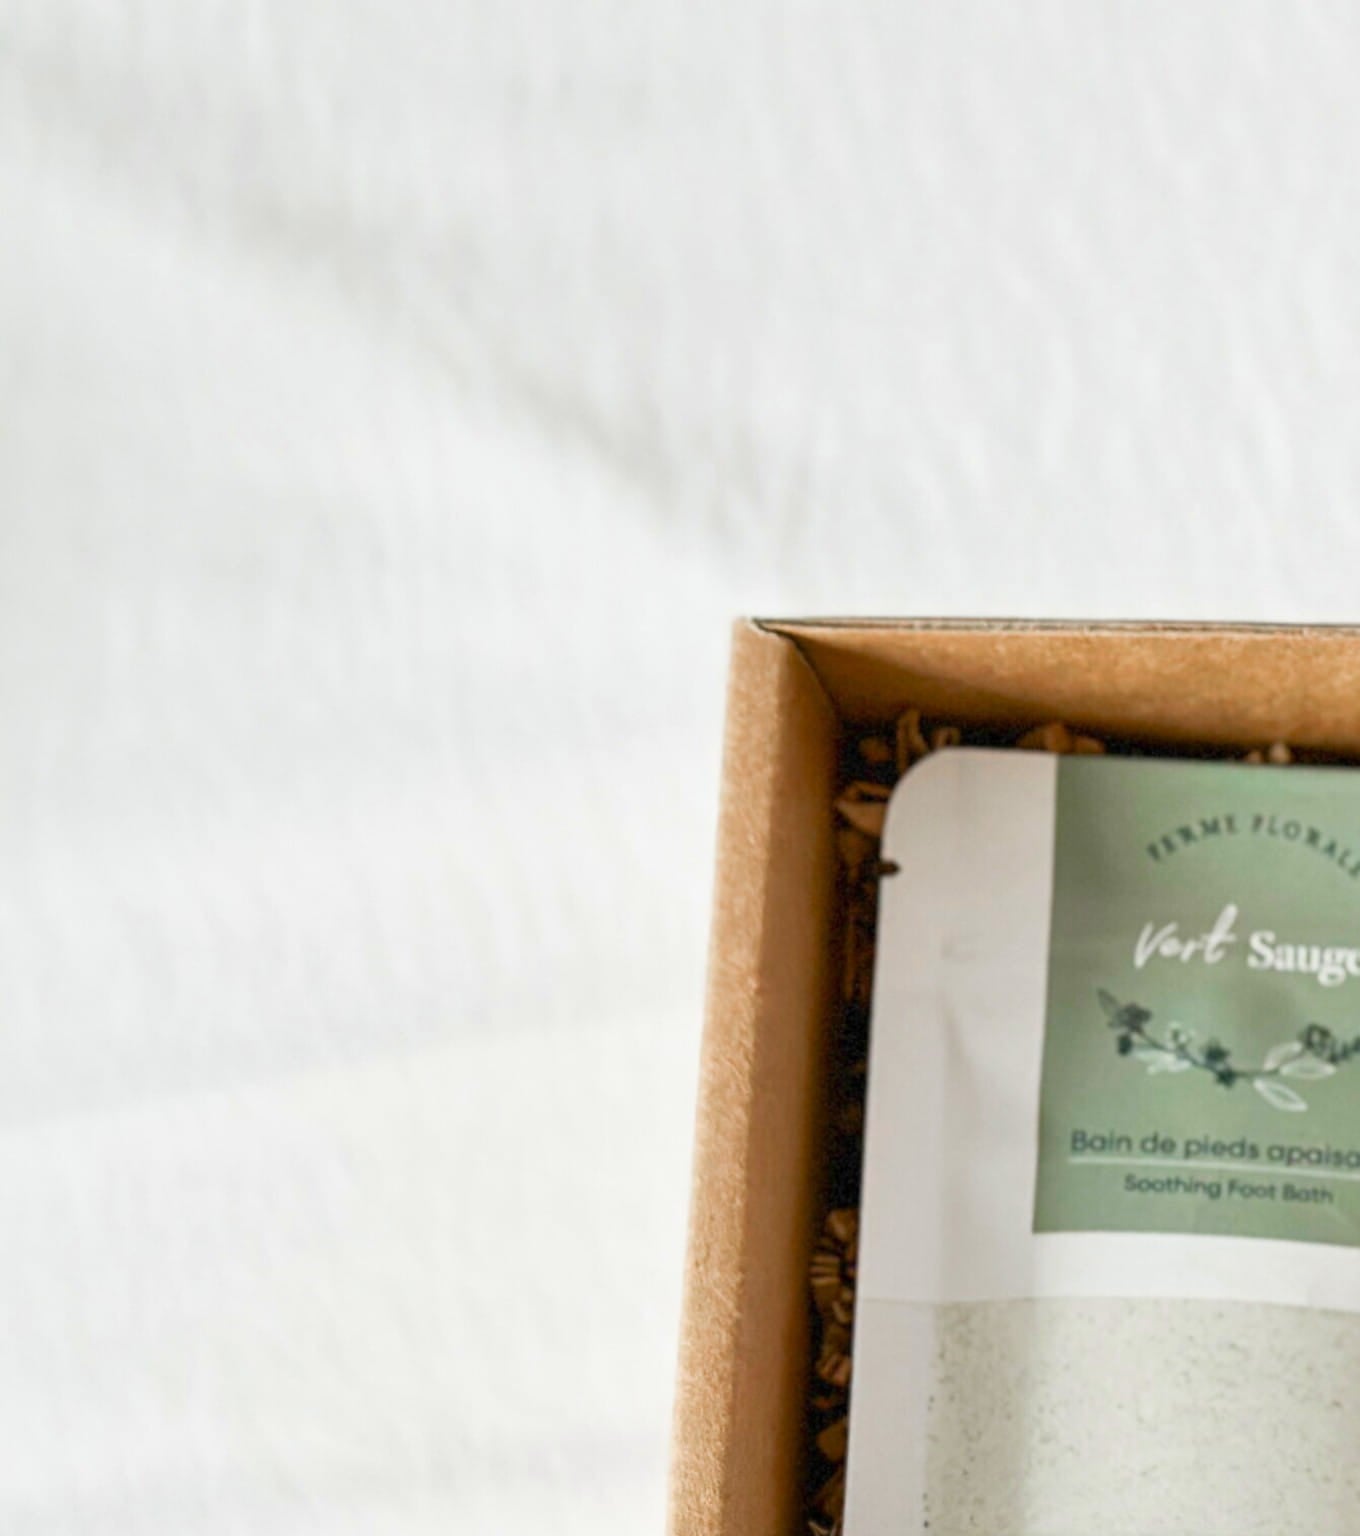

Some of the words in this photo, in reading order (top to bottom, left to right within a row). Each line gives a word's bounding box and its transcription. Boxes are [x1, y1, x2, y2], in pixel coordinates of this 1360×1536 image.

[1147, 814, 1238, 863] FERME
[1133, 903, 1239, 969] Vert
[1071, 1130, 1134, 1155] Bain
[1140, 1131, 1177, 1156] de
[1183, 1134, 1260, 1163] pieds
[1124, 1173, 1222, 1200] Soothing
[1227, 1179, 1277, 1201] Foot
[1282, 1183, 1334, 1205] Bath
